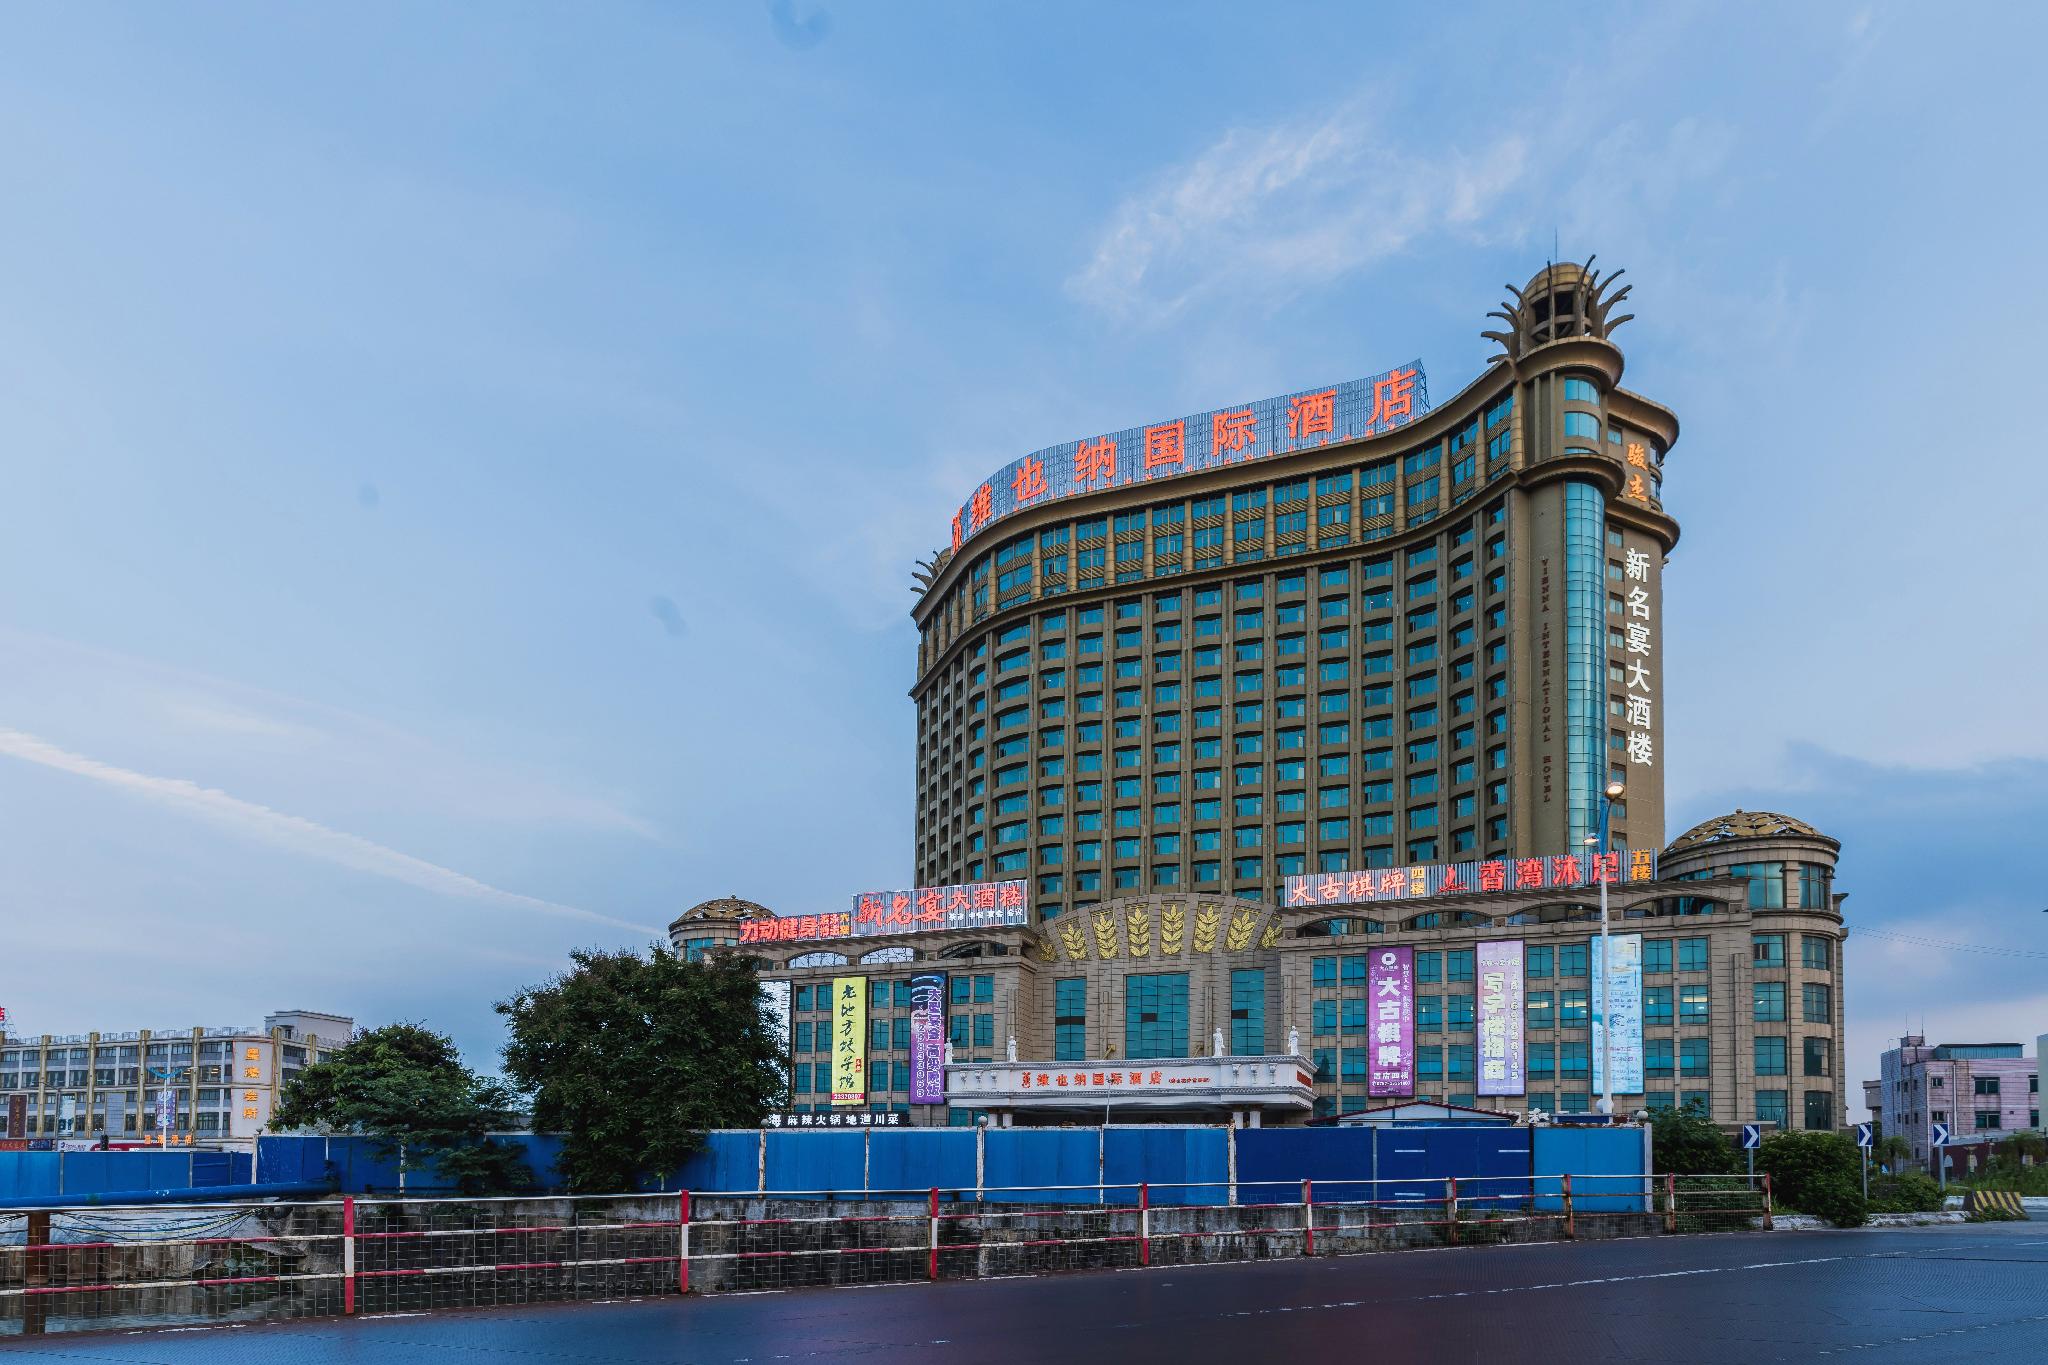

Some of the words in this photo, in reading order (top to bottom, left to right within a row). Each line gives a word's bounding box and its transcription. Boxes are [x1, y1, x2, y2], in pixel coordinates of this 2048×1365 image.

[970, 368, 1418, 534] 维也纳国际酒店
[1541, 558, 1550, 613] VIENNA
[1625, 547, 1653, 767] 新名宴大酒楼
[1541, 622, 1551, 742] INTERNATIONAL
[1542, 756, 1551, 803] HOTEL
[1410, 867, 1426, 896] 四楼
[1631, 849, 1652, 881] 五楼
[855, 885, 1024, 927] 新名宴大酒楼
[1037, 1070, 1163, 1087] 维也纳国际酒店
[787, 1114, 841, 1126] 麻辣火锅
[845, 1113, 900, 1126] 地道川菜
